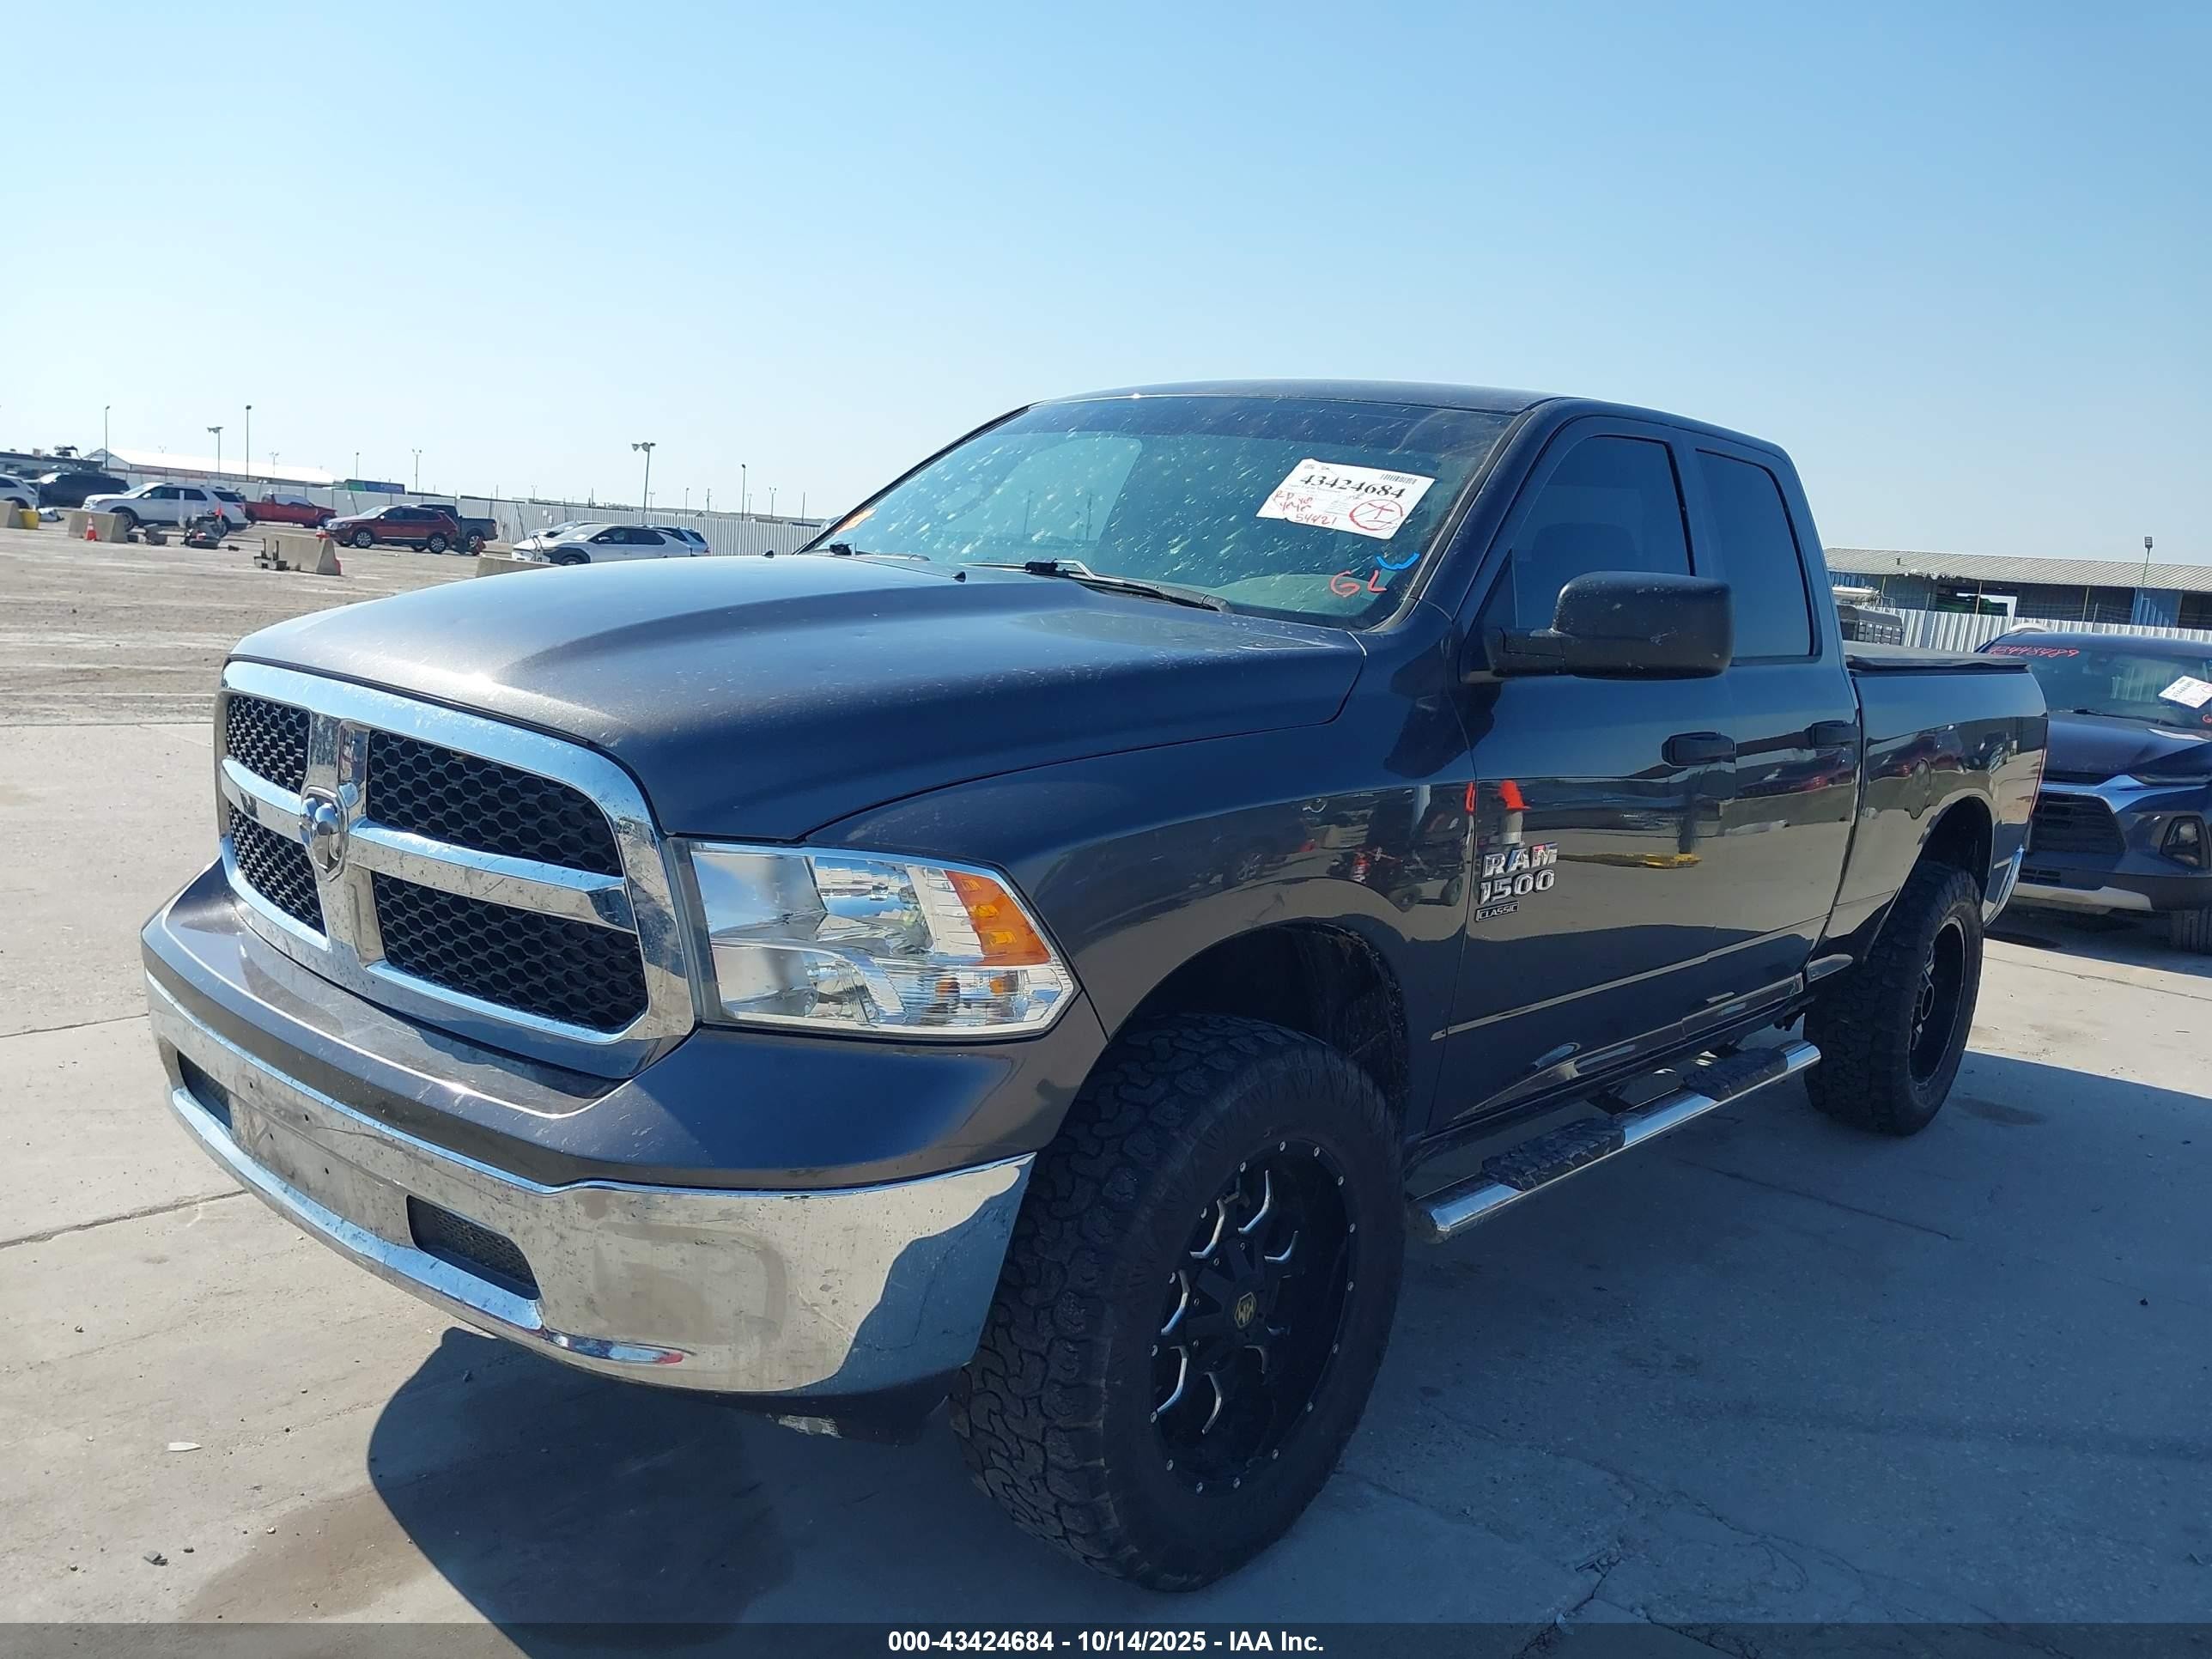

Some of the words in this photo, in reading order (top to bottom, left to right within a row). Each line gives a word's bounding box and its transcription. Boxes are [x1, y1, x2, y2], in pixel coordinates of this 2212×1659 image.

[1299, 474, 1407, 499] 43424684
[1483, 843, 1559, 878] RAM
[1478, 869, 1555, 905] 1500
[1479, 904, 1519, 920] CLASSIC
